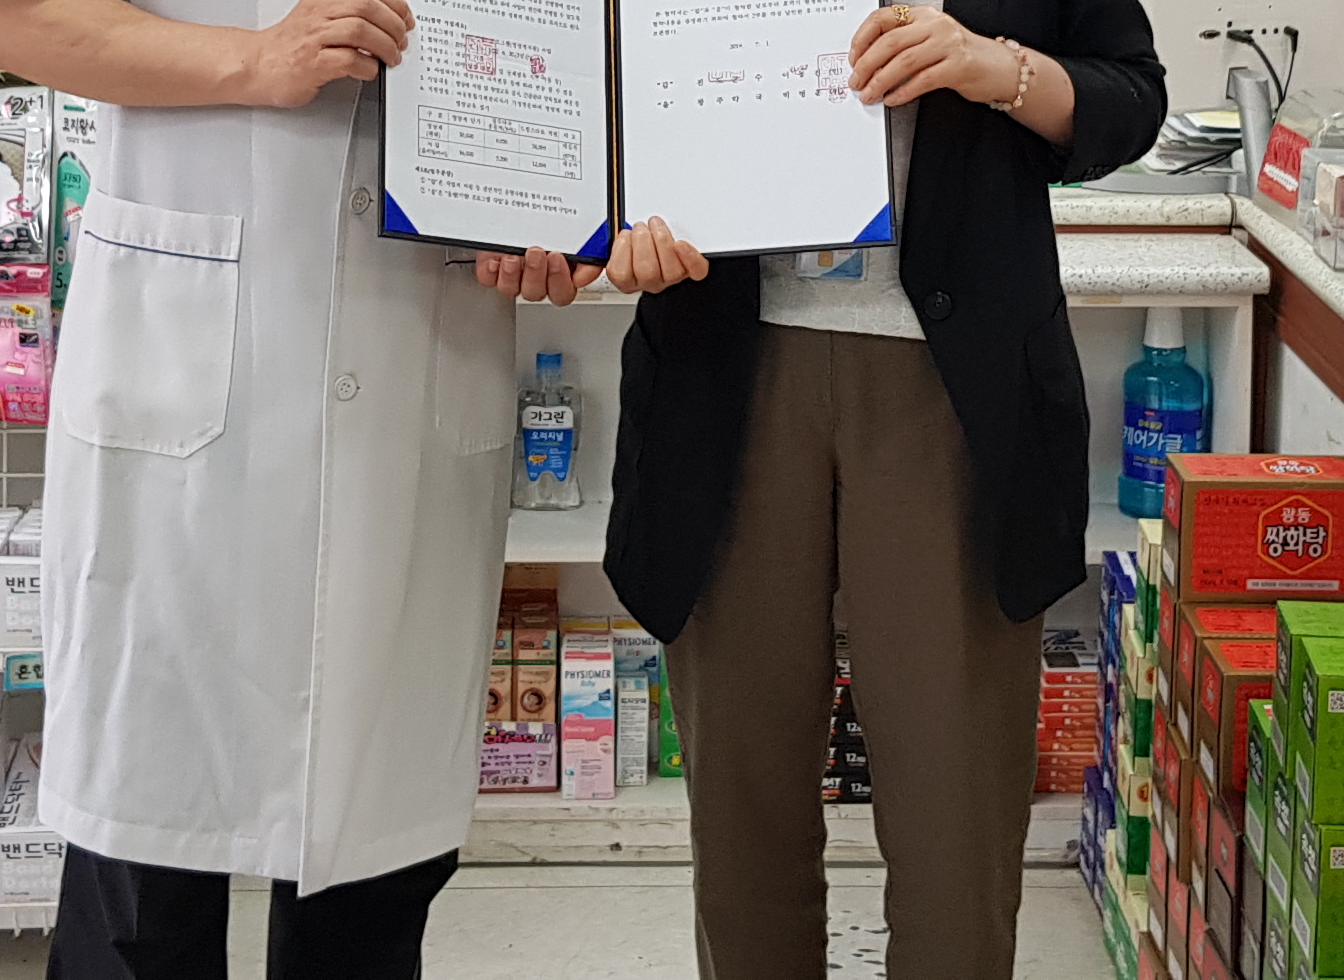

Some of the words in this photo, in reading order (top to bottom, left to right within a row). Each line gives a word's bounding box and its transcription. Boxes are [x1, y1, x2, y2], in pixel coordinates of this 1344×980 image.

[530, 410, 566, 424] 가그린
[1281, 507, 1310, 524] 광동
[1263, 527, 1327, 560] 쌍화탕
[565, 670, 611, 680] PHYSIOMER
